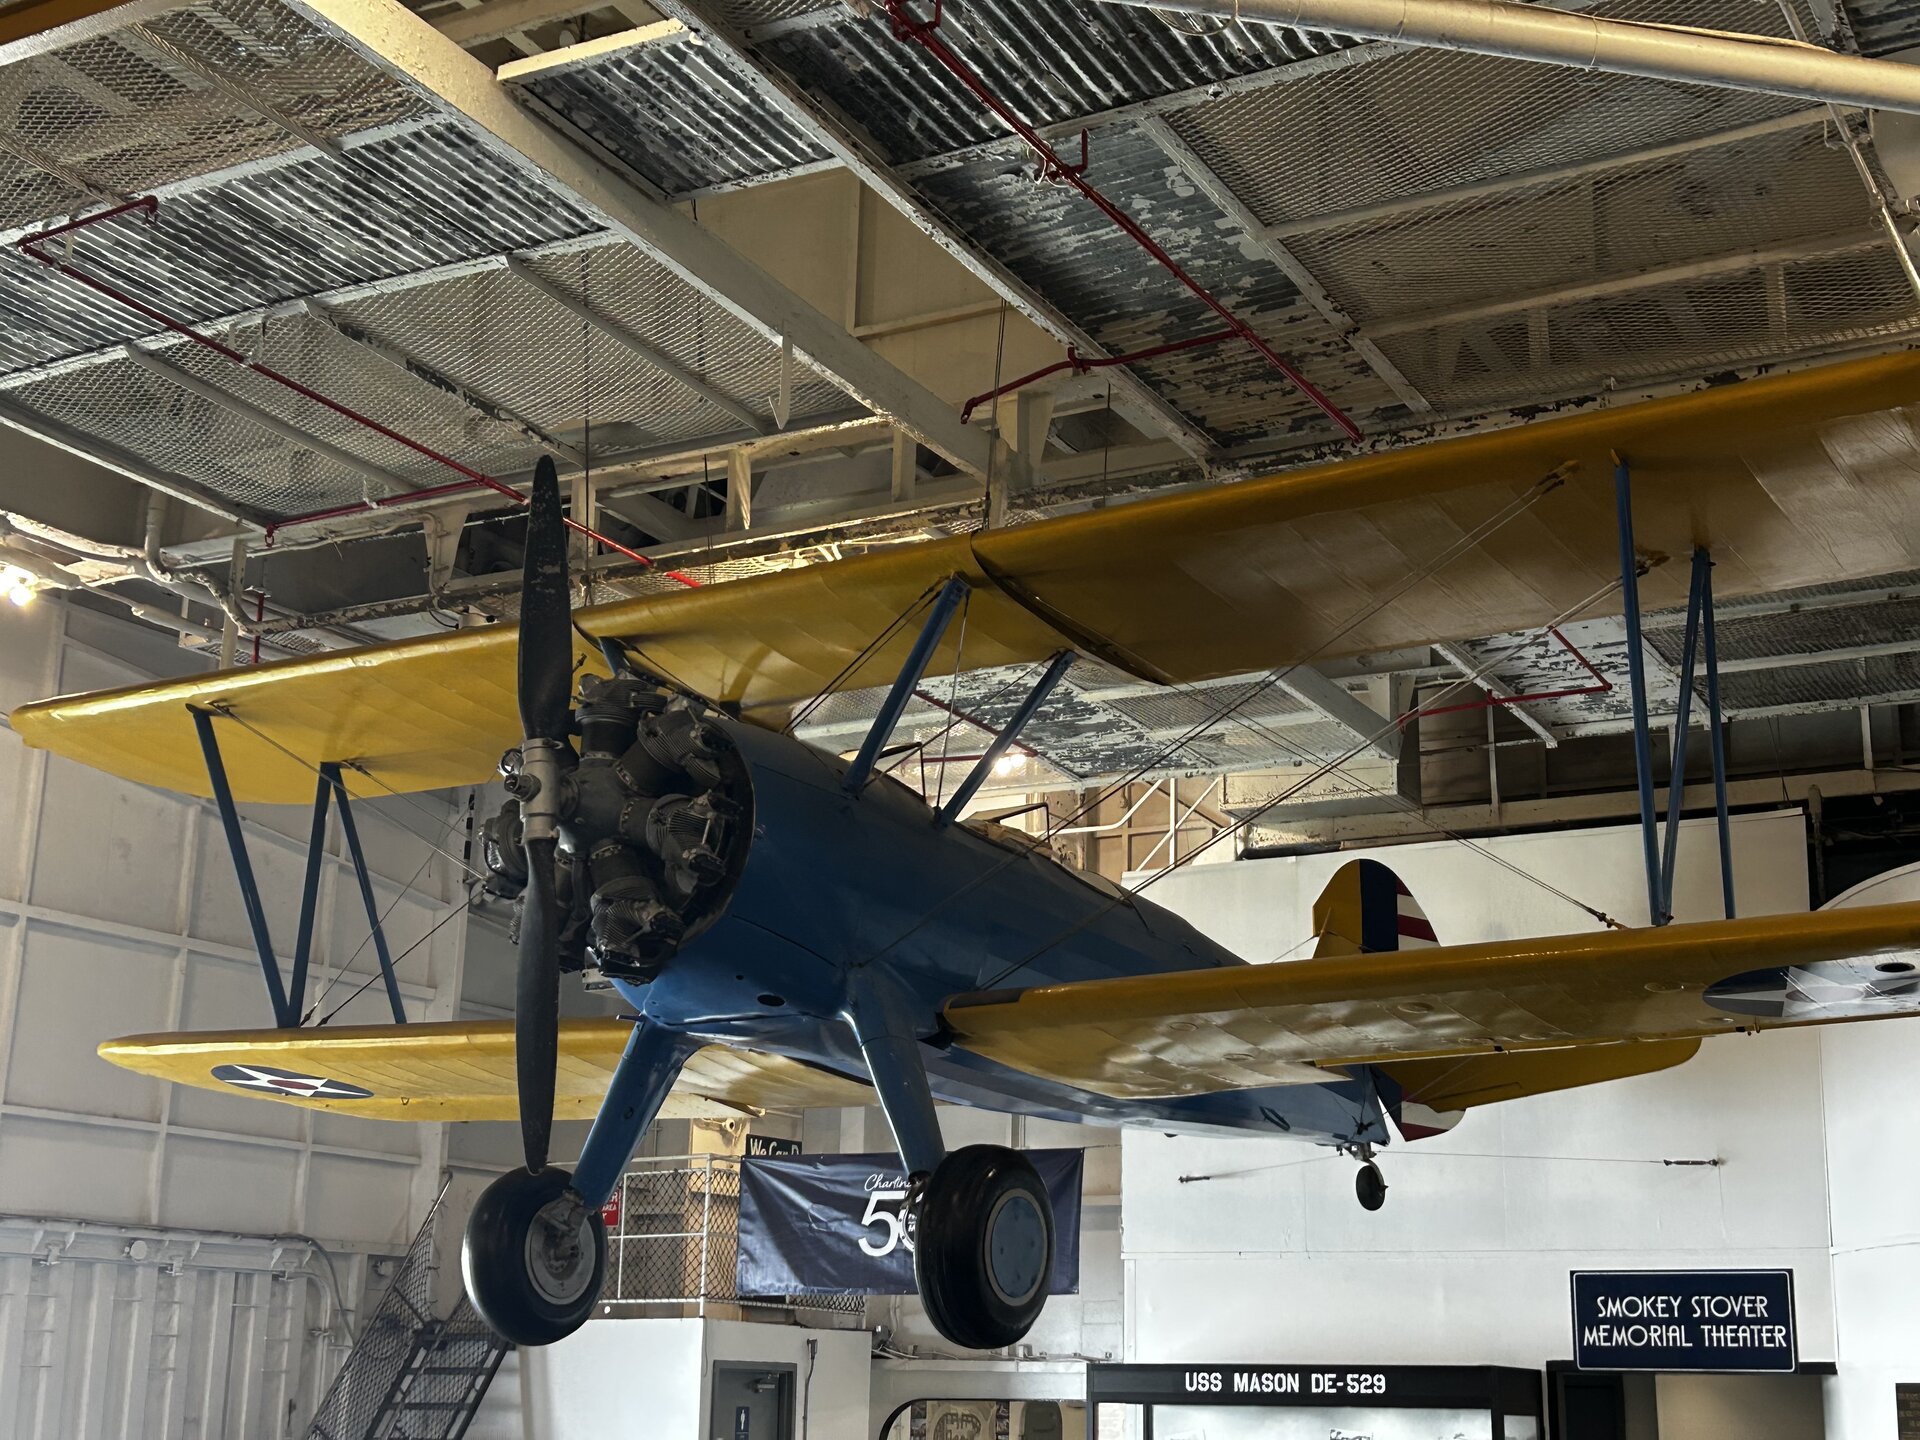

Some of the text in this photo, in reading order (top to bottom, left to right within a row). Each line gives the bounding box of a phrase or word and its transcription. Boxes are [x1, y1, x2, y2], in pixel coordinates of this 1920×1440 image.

[750, 1138, 767, 1156] We
[1597, 1296, 1769, 1318] SMOKEY STOVER
[1584, 1325, 1787, 1348] MEMORIAL THEATER
[1185, 1371, 1386, 1394] USS MASON DE-529
